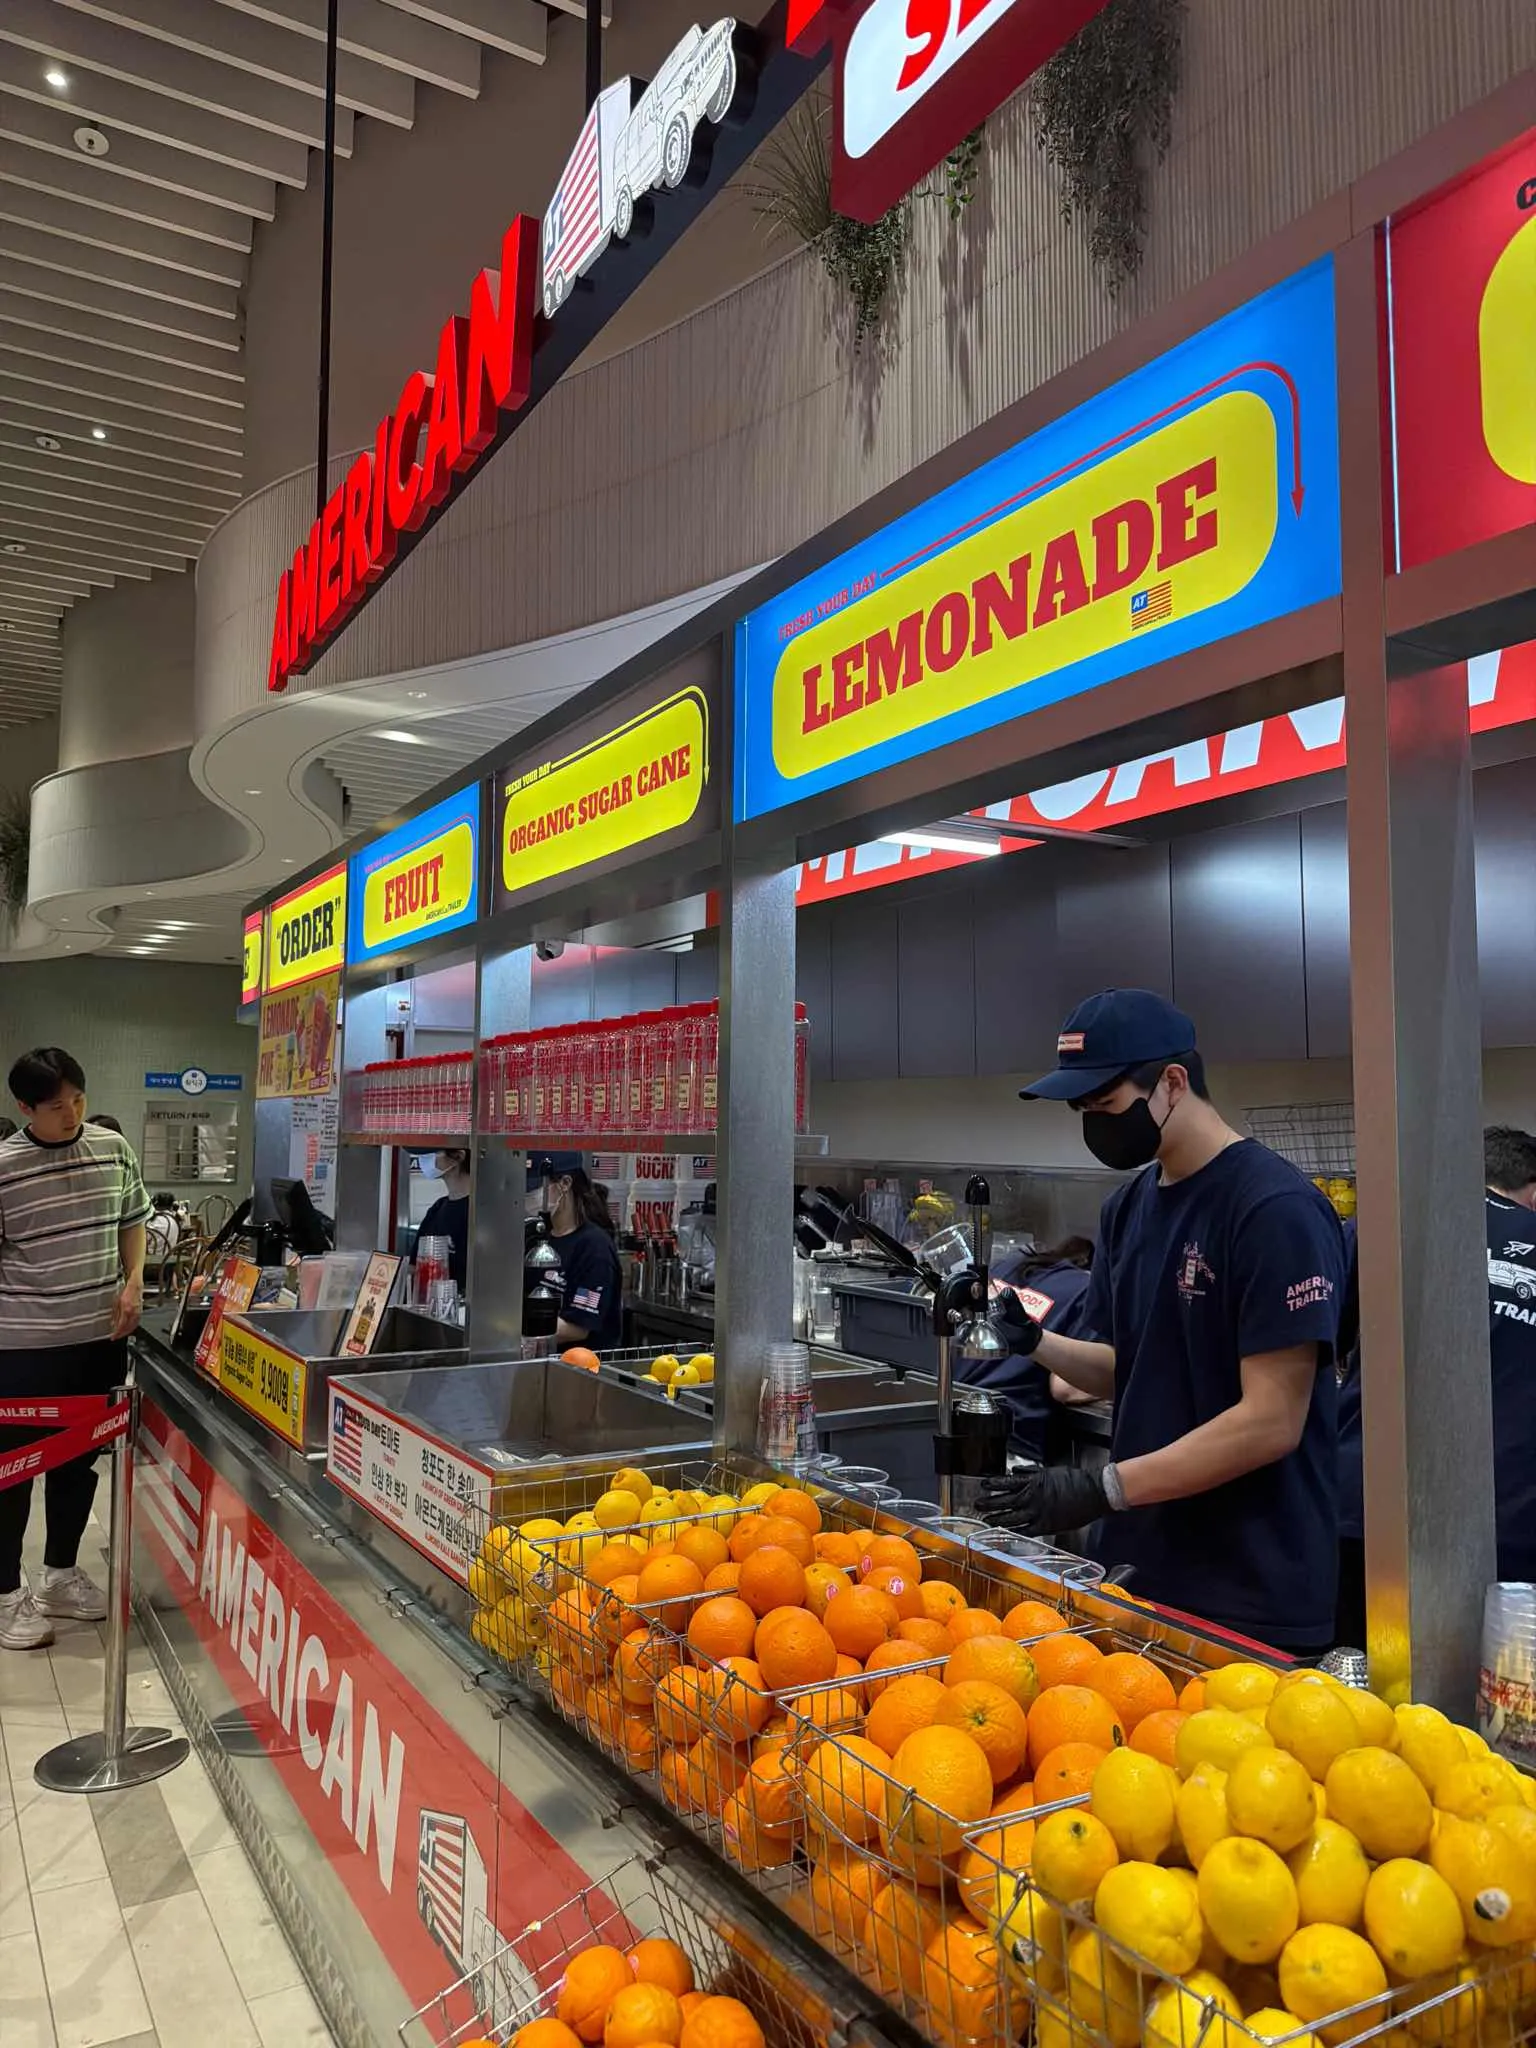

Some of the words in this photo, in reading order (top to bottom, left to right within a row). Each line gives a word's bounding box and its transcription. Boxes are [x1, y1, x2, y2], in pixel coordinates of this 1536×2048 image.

[268, 213, 539, 692] AMERICAN
[778, 609, 813, 641] FRESH
[817, 589, 848, 618] YOUR
[852, 570, 876, 598] DAY
[802, 456, 1218, 735] LEMONADE
[1132, 593, 1147, 611] AT
[505, 775, 521, 797] FRESH
[522, 767, 538, 786] YOUR
[538, 760, 551, 780] DAY
[508, 802, 575, 855] ORGANIC
[578, 775, 632, 825] SUGAR
[637, 744, 690, 797] CANE
[384, 854, 444, 924] FRUIT
[261, 1357, 290, 1415] 9,900원
[91, 1410, 130, 1440] AMERICAN
[380, 1424, 400, 1455] 토마토
[371, 1462, 384, 1491] 인삼
[386, 1472, 393, 1498] 한
[422, 1448, 444, 1484] 청포도
[447, 1463, 455, 1491] 한
[199, 1509, 405, 1895] AMERICAN
